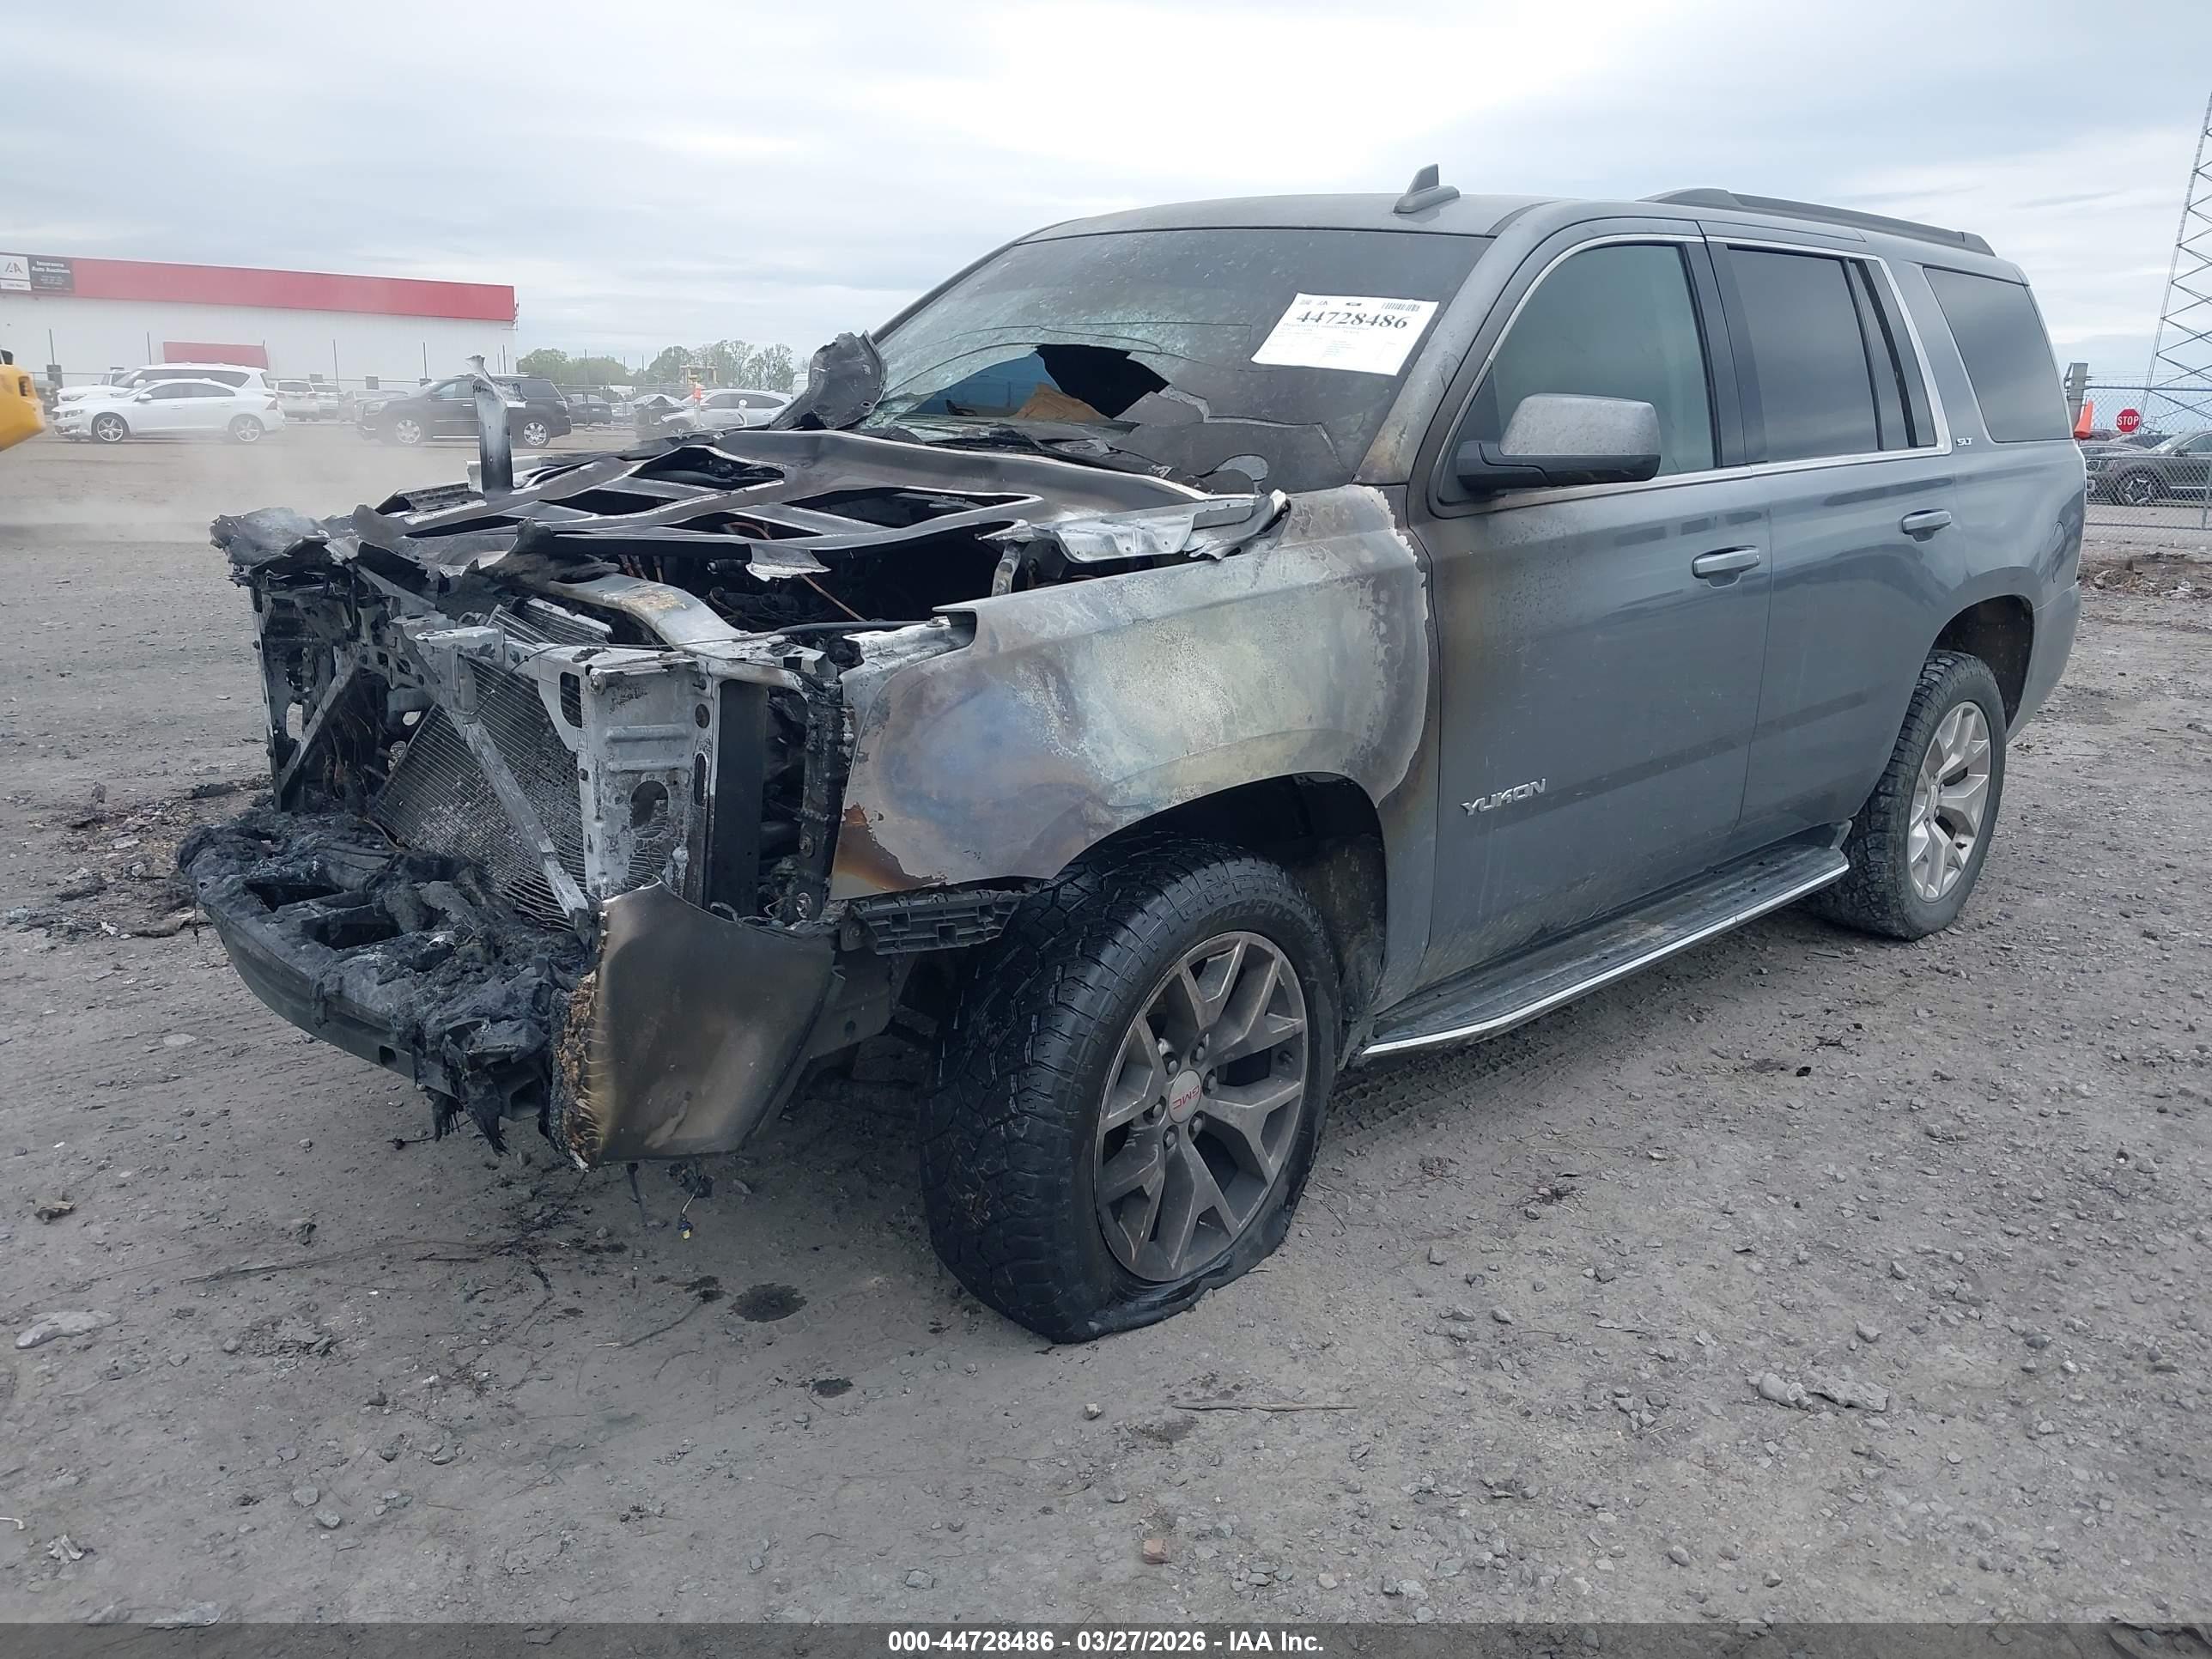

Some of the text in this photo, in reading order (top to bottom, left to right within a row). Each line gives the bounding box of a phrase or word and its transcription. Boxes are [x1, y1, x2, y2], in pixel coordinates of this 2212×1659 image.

[1297, 310, 1411, 329] 44728486
[2117, 416, 2139, 426] STOP
[1460, 777, 1546, 817] YUKON
[1173, 1085, 1200, 1109] GMC
